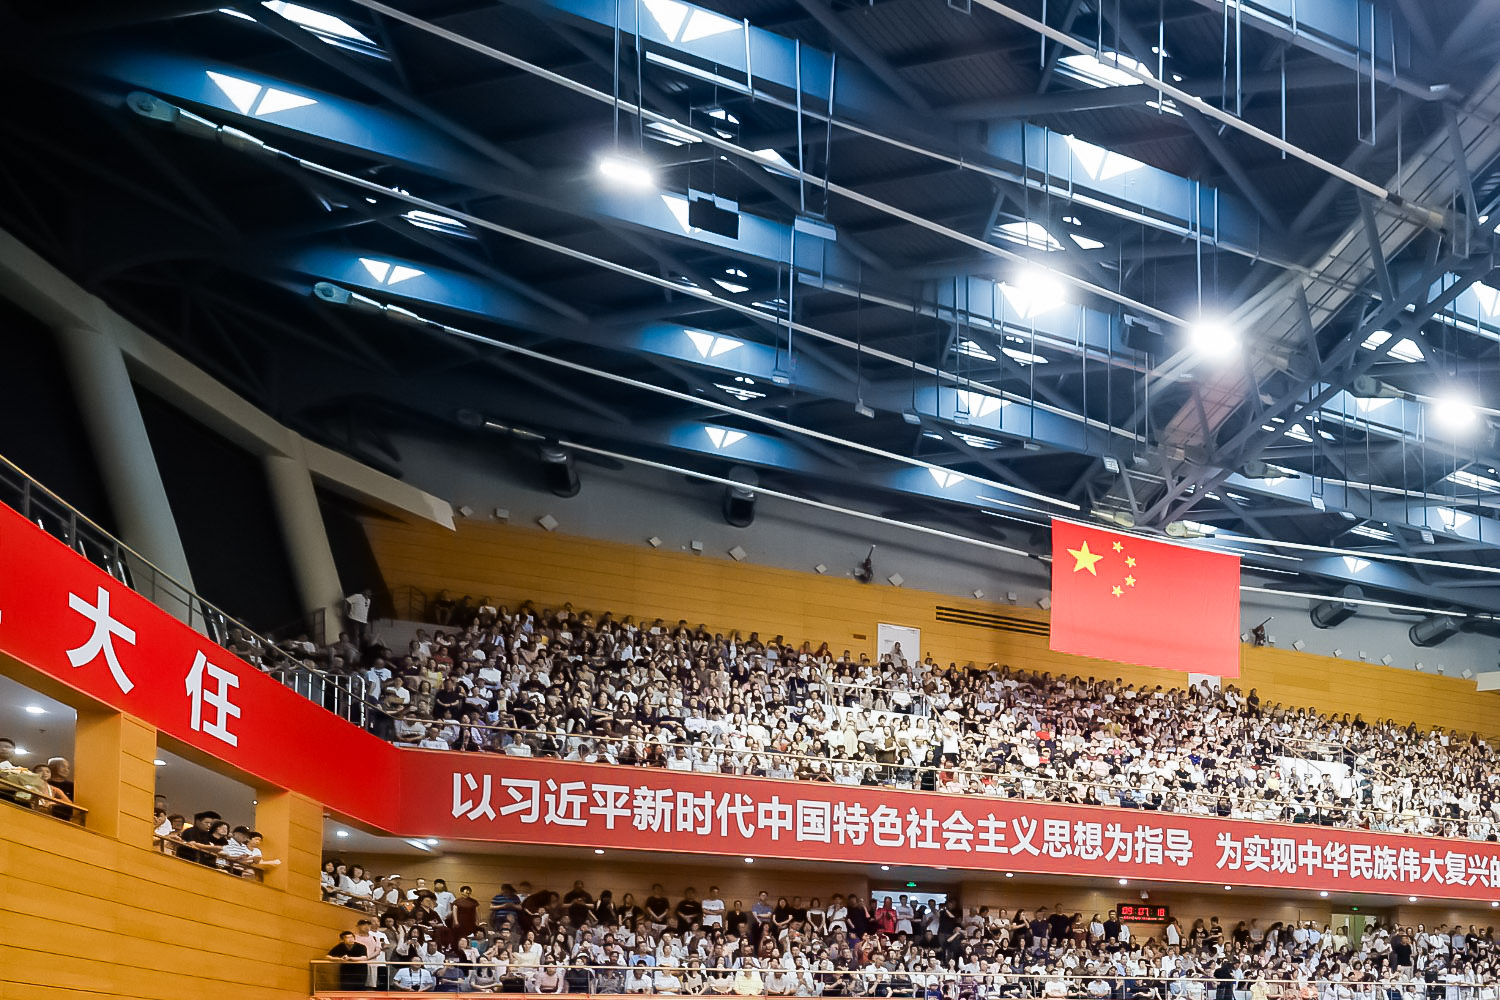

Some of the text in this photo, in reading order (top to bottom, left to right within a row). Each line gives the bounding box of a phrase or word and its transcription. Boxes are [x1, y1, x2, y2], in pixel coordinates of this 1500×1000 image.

[451, 772, 1194, 867] 以习近平新时代中国特色社会主义思想为指导
